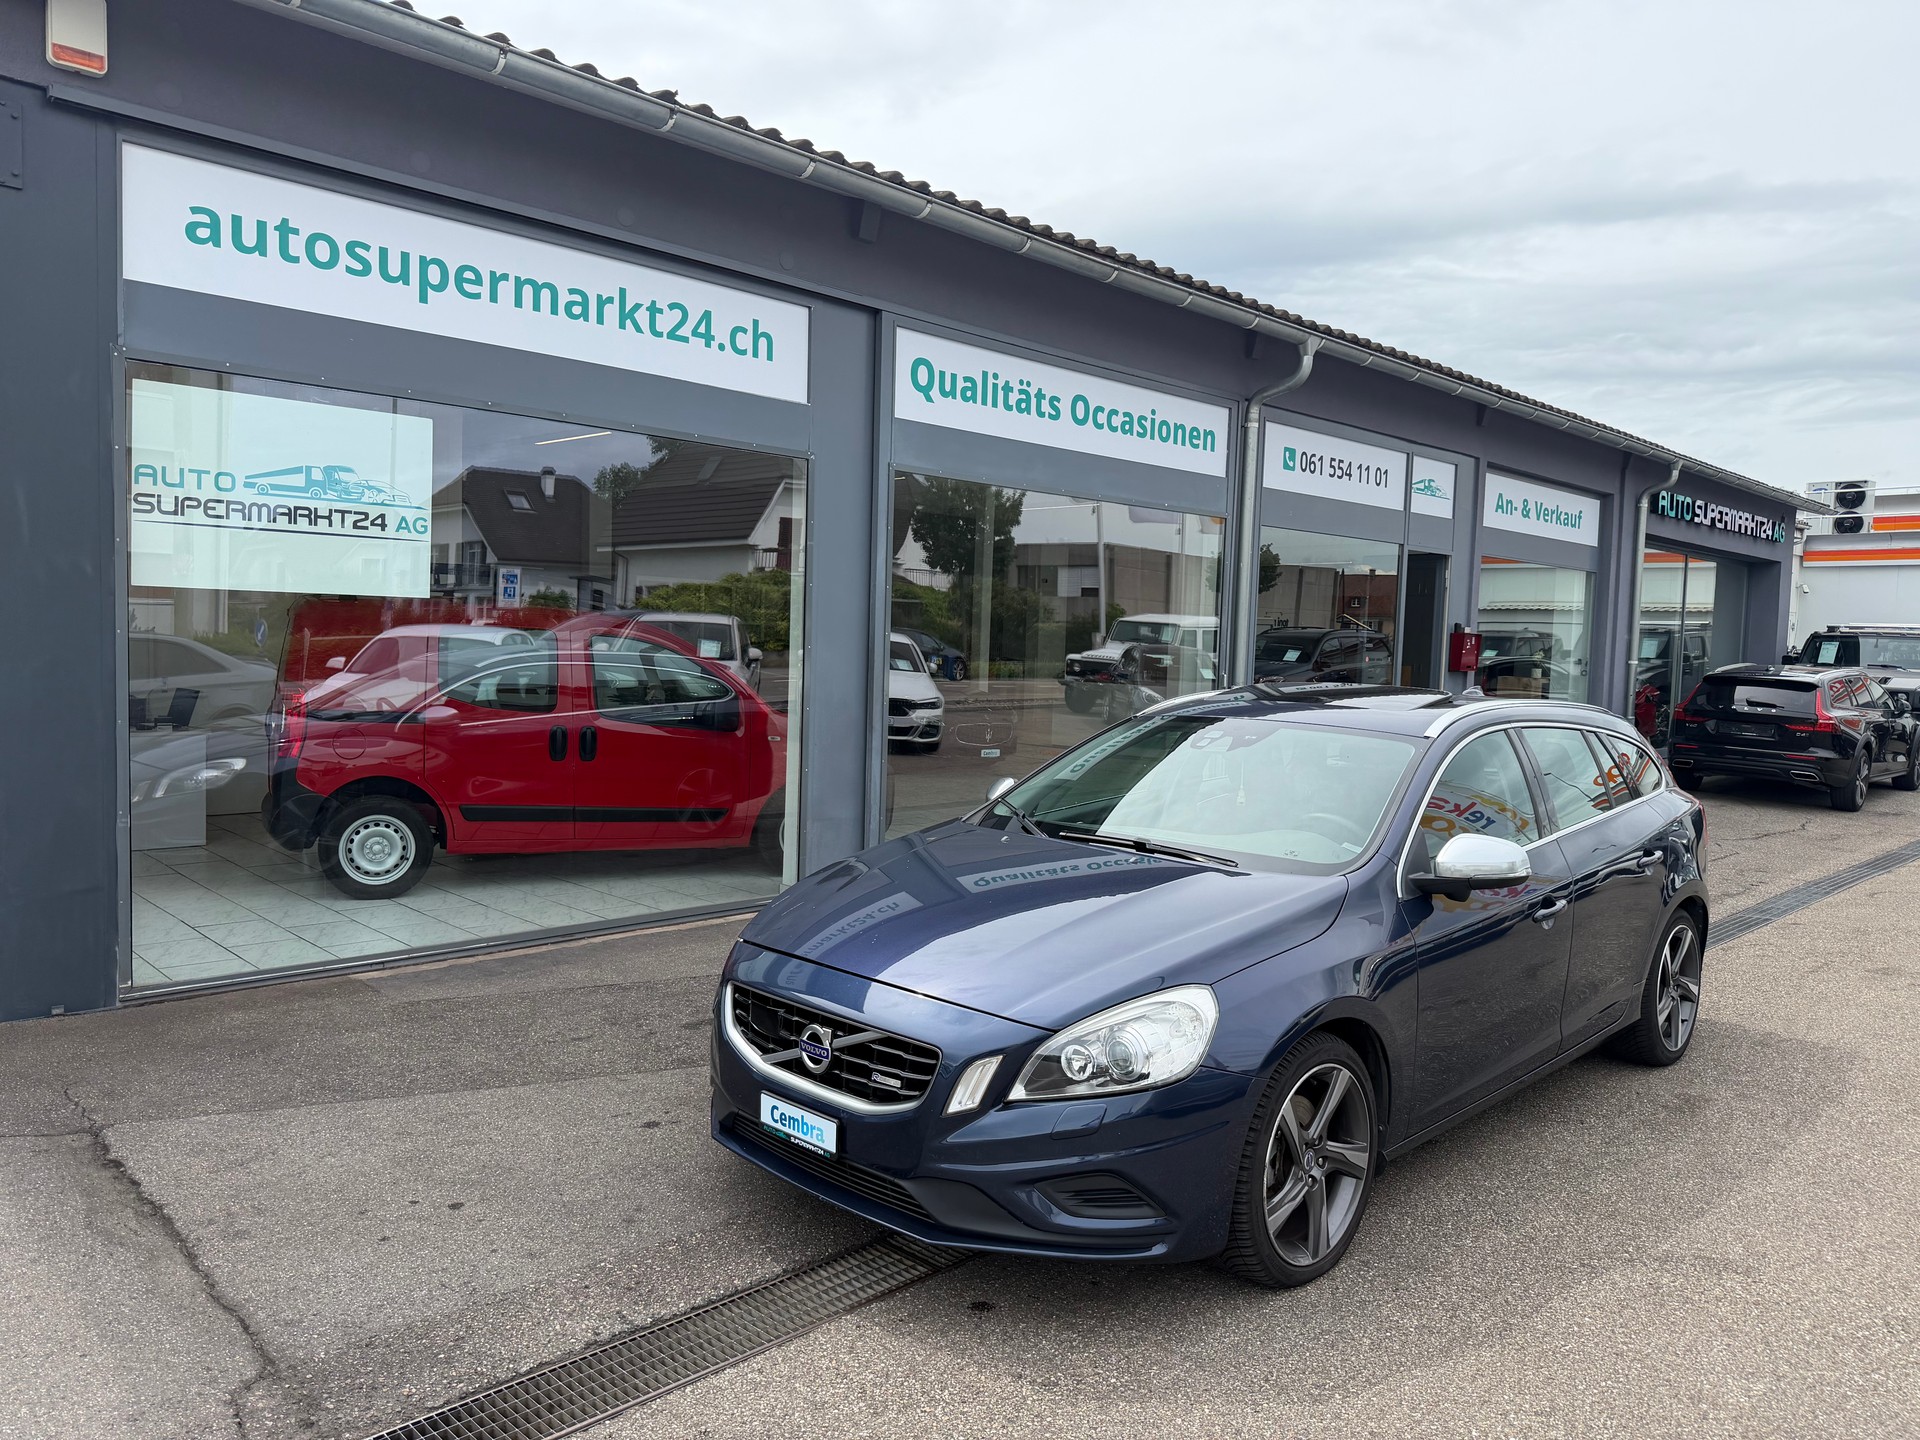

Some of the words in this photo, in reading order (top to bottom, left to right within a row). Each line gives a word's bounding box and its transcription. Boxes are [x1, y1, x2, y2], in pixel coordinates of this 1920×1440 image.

[184, 206, 775, 362] autosupermarkt24.ch
[910, 357, 1062, 421] Qualitäts
[1070, 394, 1216, 452] Occasionen
[134, 464, 236, 492] AUTO
[1300, 451, 1324, 476] 061
[1328, 457, 1353, 481] 554
[1356, 463, 1370, 485] 11
[1374, 467, 1389, 488] 01
[133, 492, 388, 532] SUPERMARKT24
[394, 516, 429, 534] AG
[1495, 493, 1518, 516] An-
[1521, 498, 1531, 519] &
[1534, 501, 1583, 529] Verkauf
[1658, 490, 1692, 521] AUTO
[1694, 500, 1773, 540] SUPERMARKT24
[1773, 521, 1786, 543] AG
[800, 1042, 828, 1057] VOLVO
[770, 1104, 825, 1144] Cembra
